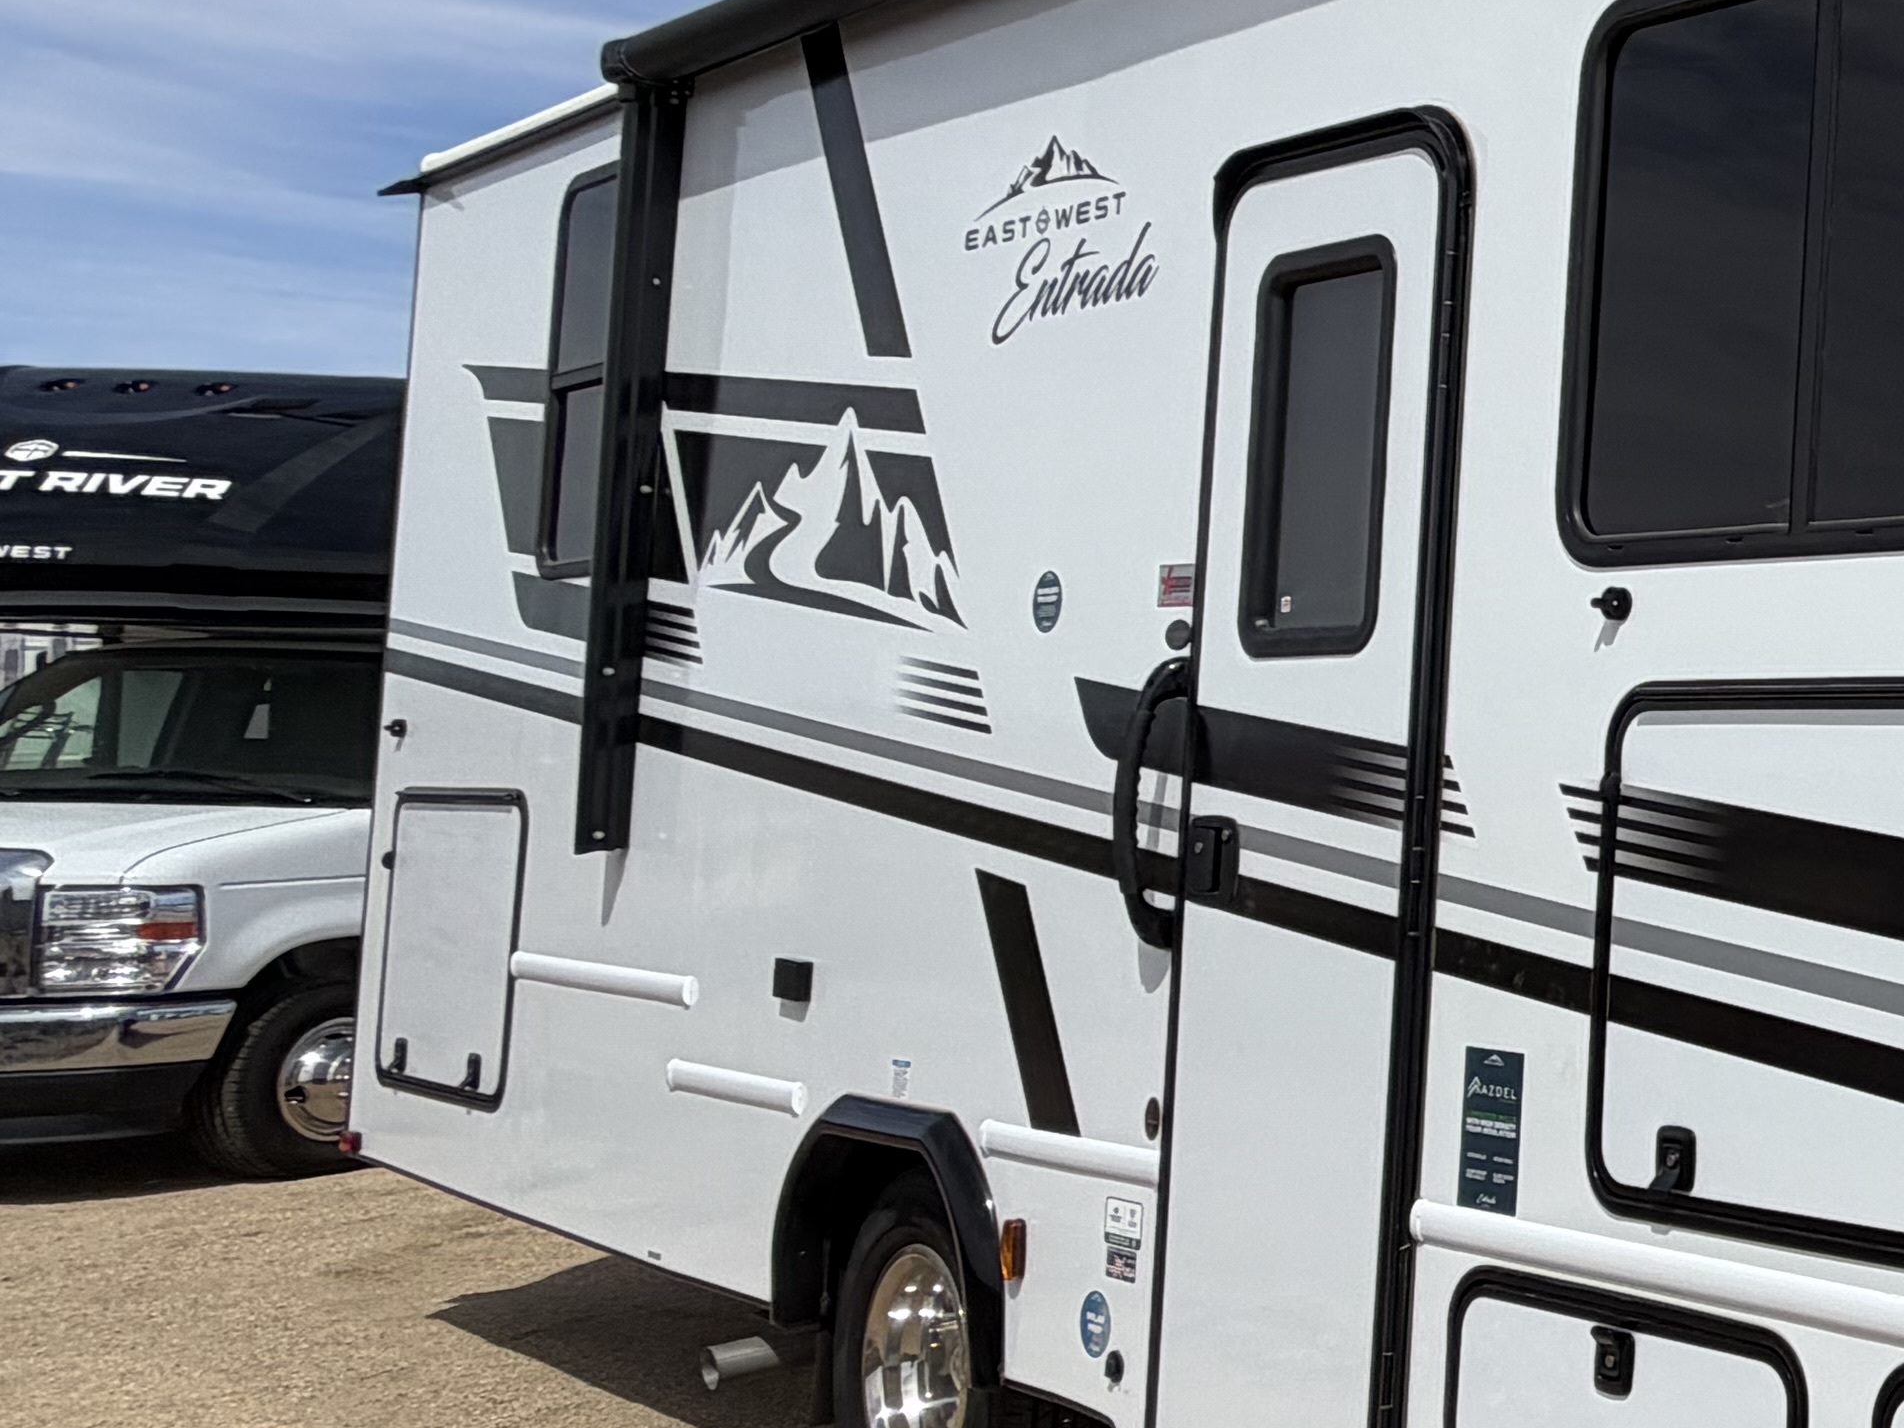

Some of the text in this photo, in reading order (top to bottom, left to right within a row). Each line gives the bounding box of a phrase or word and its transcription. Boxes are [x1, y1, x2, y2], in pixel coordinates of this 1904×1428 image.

[965, 191, 1126, 251] EAST WEST
[991, 221, 1160, 346] Entrada
[38, 470, 233, 500] RIVER
[1480, 1083, 1517, 1100] AZDEL
